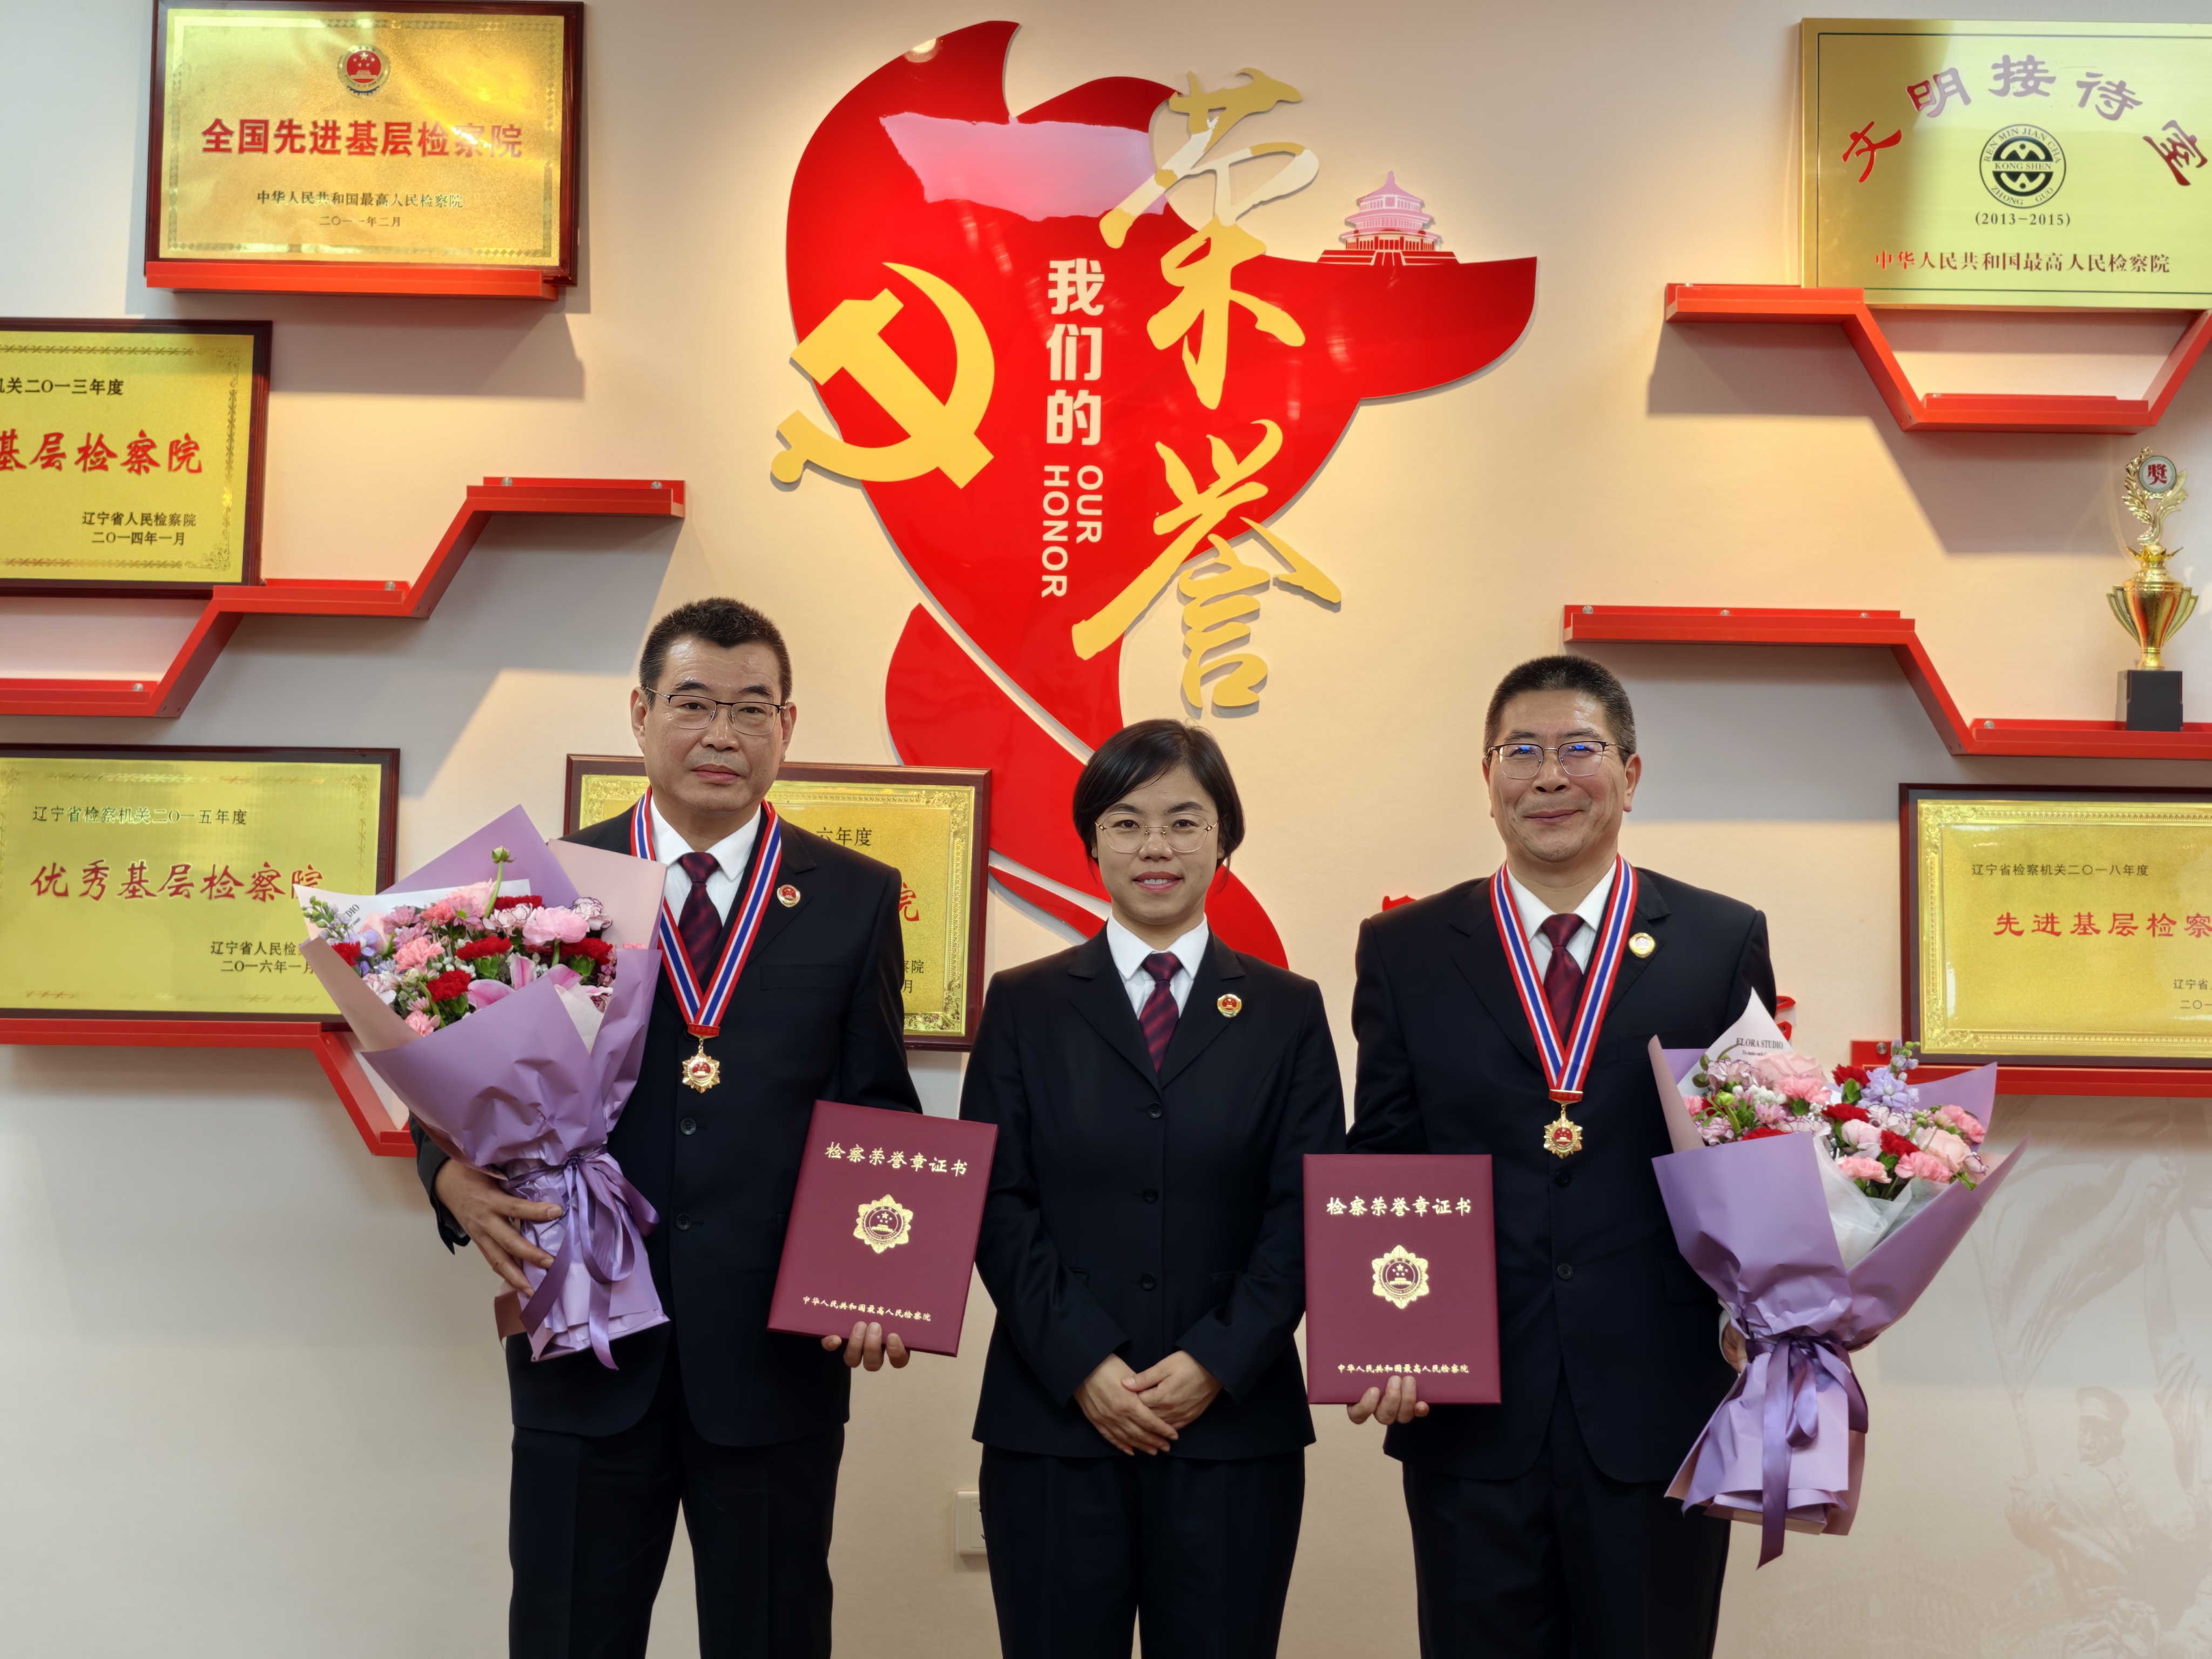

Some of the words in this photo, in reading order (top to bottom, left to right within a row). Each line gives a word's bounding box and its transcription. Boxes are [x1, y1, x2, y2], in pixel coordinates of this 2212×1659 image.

[1842, 54, 2208, 186] 文明接待室
[201, 118, 523, 158] 全国先进基层检察院
[1984, 140, 1998, 163] REN
[1998, 127, 2019, 141] MIN
[2022, 127, 2048, 142] JIAN
[2047, 141, 2061, 164] CHA
[1995, 163, 2023, 171] KONG
[2025, 163, 2052, 171] SHEN
[257, 190, 464, 209] 中华人民共和国最高人民检察院
[1991, 185, 2024, 206] ZHONG
[2035, 187, 2054, 203] GUO
[1875, 250, 2170, 274] 中华人民共和国最高人民检察院
[1046, 258, 1105, 446] 我们的
[1071, 67, 1341, 709] 荣誉
[0, 428, 203, 476] 基层检察院
[1076, 464, 1104, 545] OUR
[82, 511, 197, 527] 辽宁省人民检察院
[1041, 464, 1070, 599] HONOR
[345, 904, 360, 918] DIO
[1993, 912, 2212, 938] 先进基层检察
[211, 941, 304, 956] 辽宁省人民检
[2174, 979, 2212, 990] 辽宁省
[1761, 1040, 1783, 1049] STUDIO
[825, 1141, 968, 1177] 检察荣誉章证书
[1326, 1196, 1472, 1217] 检察荣誉章证书
[802, 1295, 932, 1322] 中华人民共和国最高人民检察院
[1337, 1363, 1469, 1374] 中华人民共和国最高人民检察院
